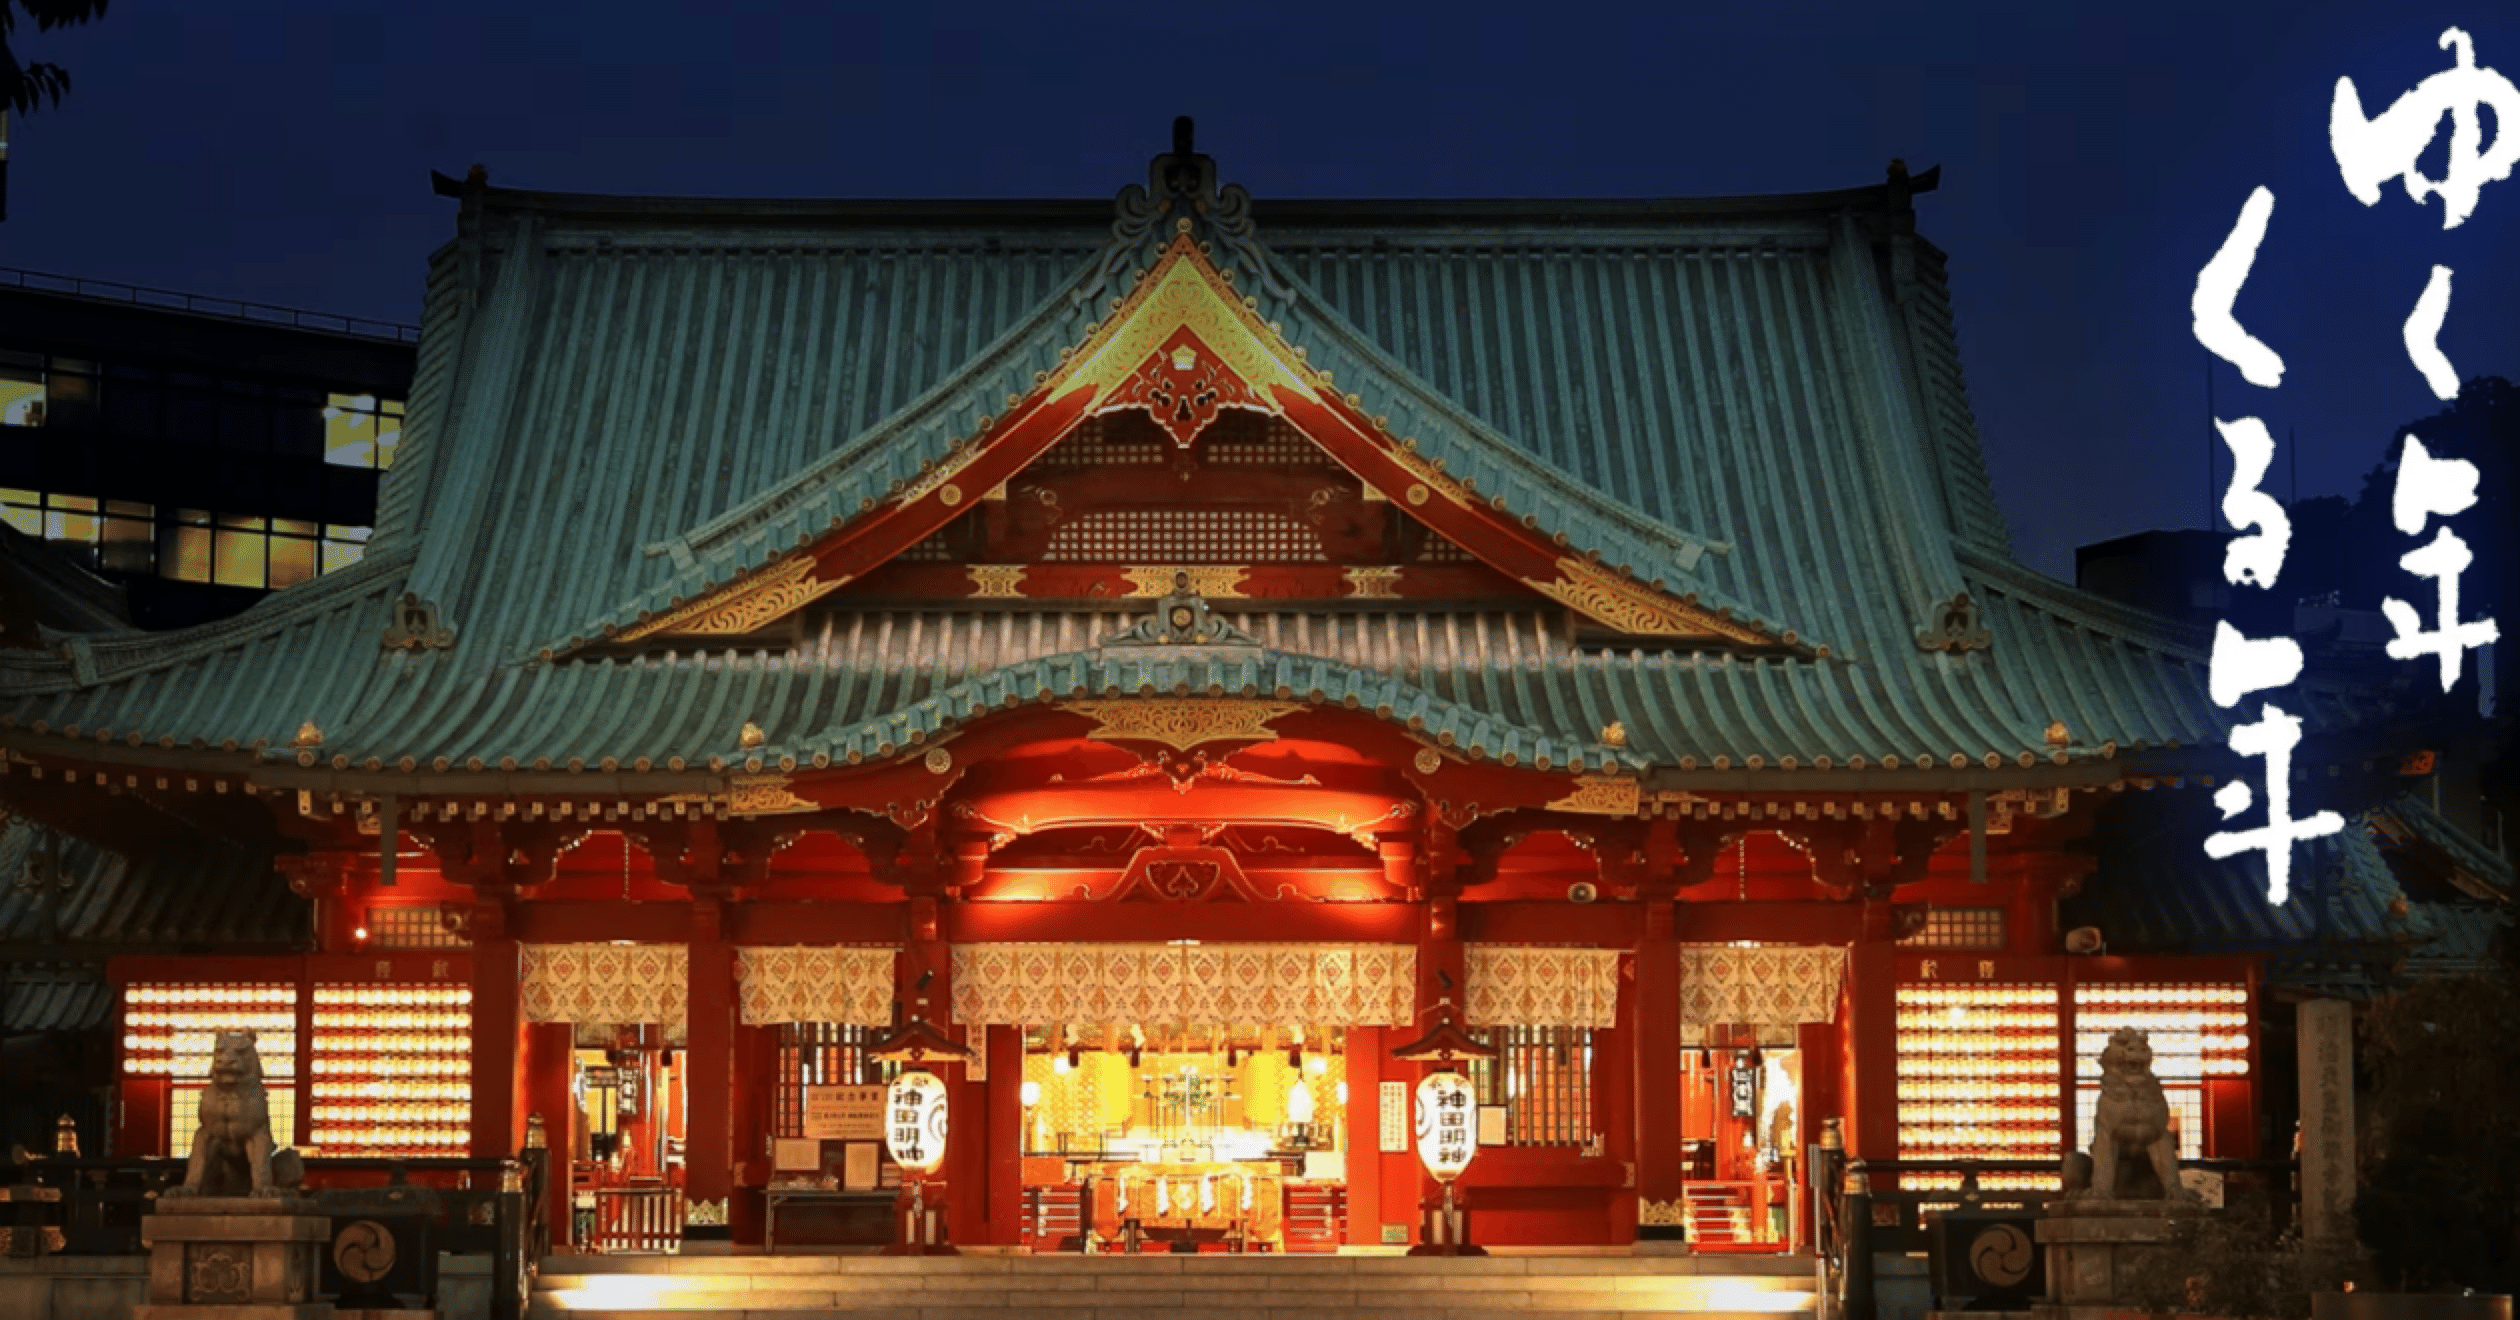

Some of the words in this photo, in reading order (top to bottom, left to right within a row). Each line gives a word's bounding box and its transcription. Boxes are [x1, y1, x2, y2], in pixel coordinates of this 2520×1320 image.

[894, 1087, 924, 1162] 神田明神
[1437, 1089, 1467, 1163] 神田明神
